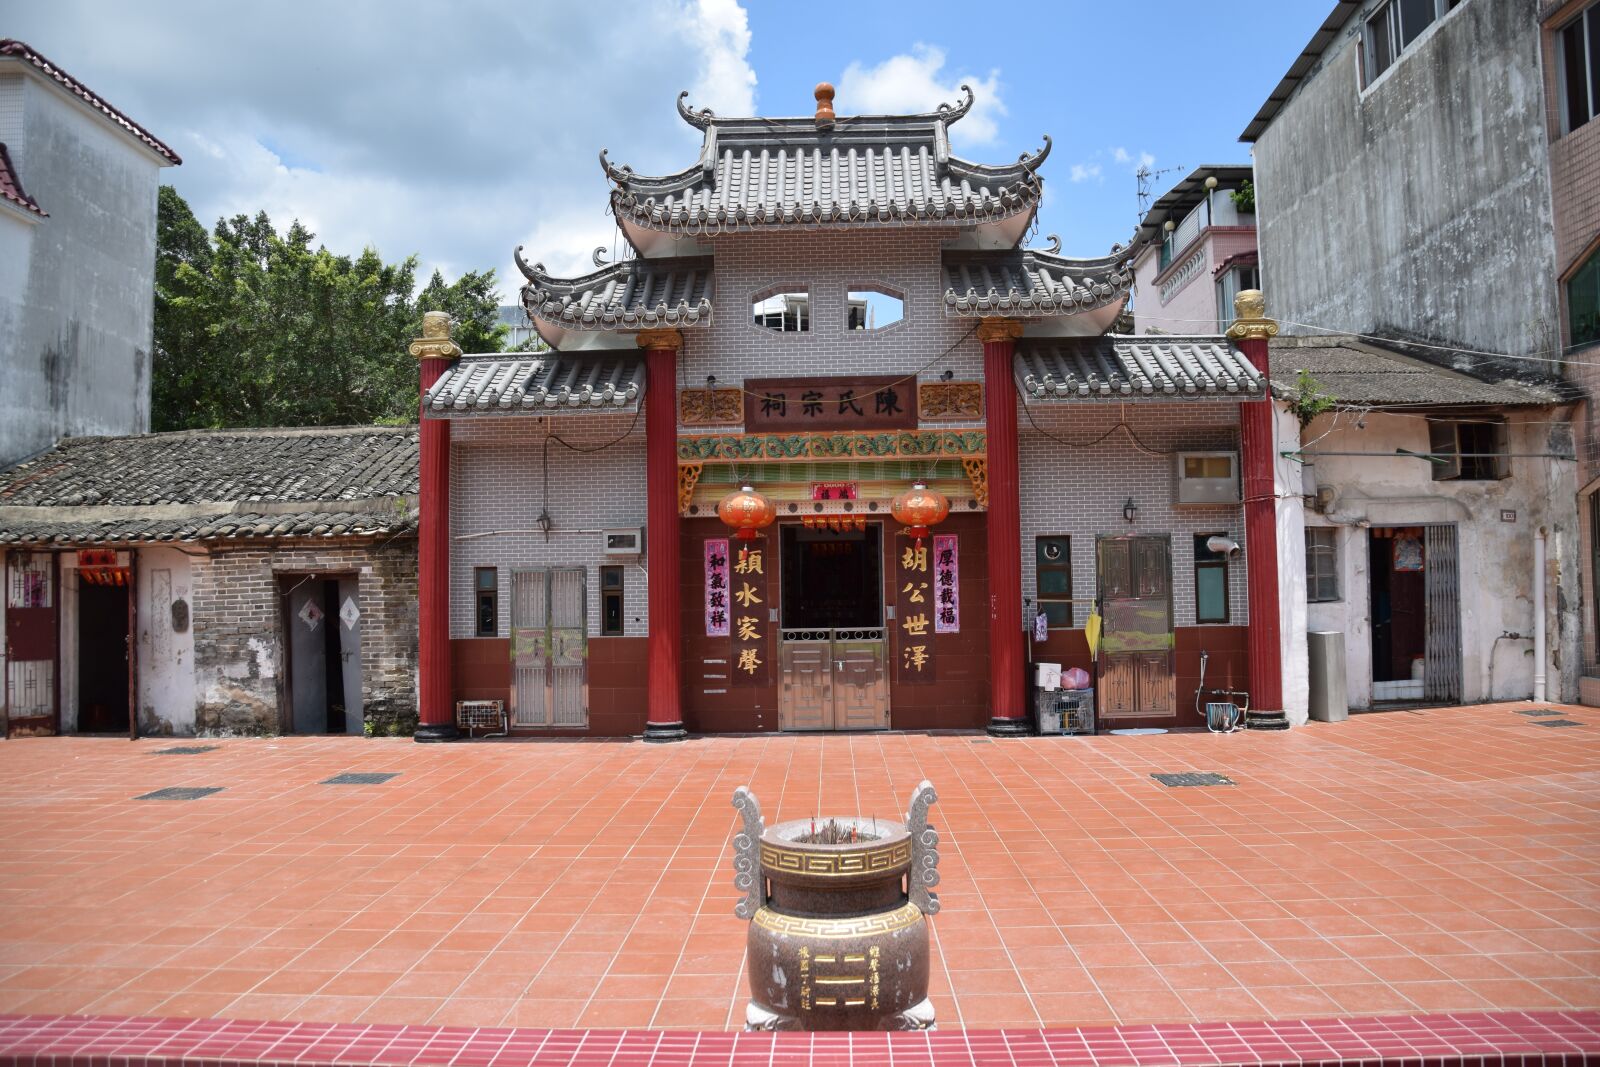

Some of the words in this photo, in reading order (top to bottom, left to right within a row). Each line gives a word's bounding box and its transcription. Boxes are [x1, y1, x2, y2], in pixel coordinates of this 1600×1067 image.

[760, 387, 903, 417] 陳氏宗祠
[709, 553, 727, 628] 和氣致祥
[901, 547, 930, 672] 胡公世澤
[938, 549, 956, 624] 厚德載福
